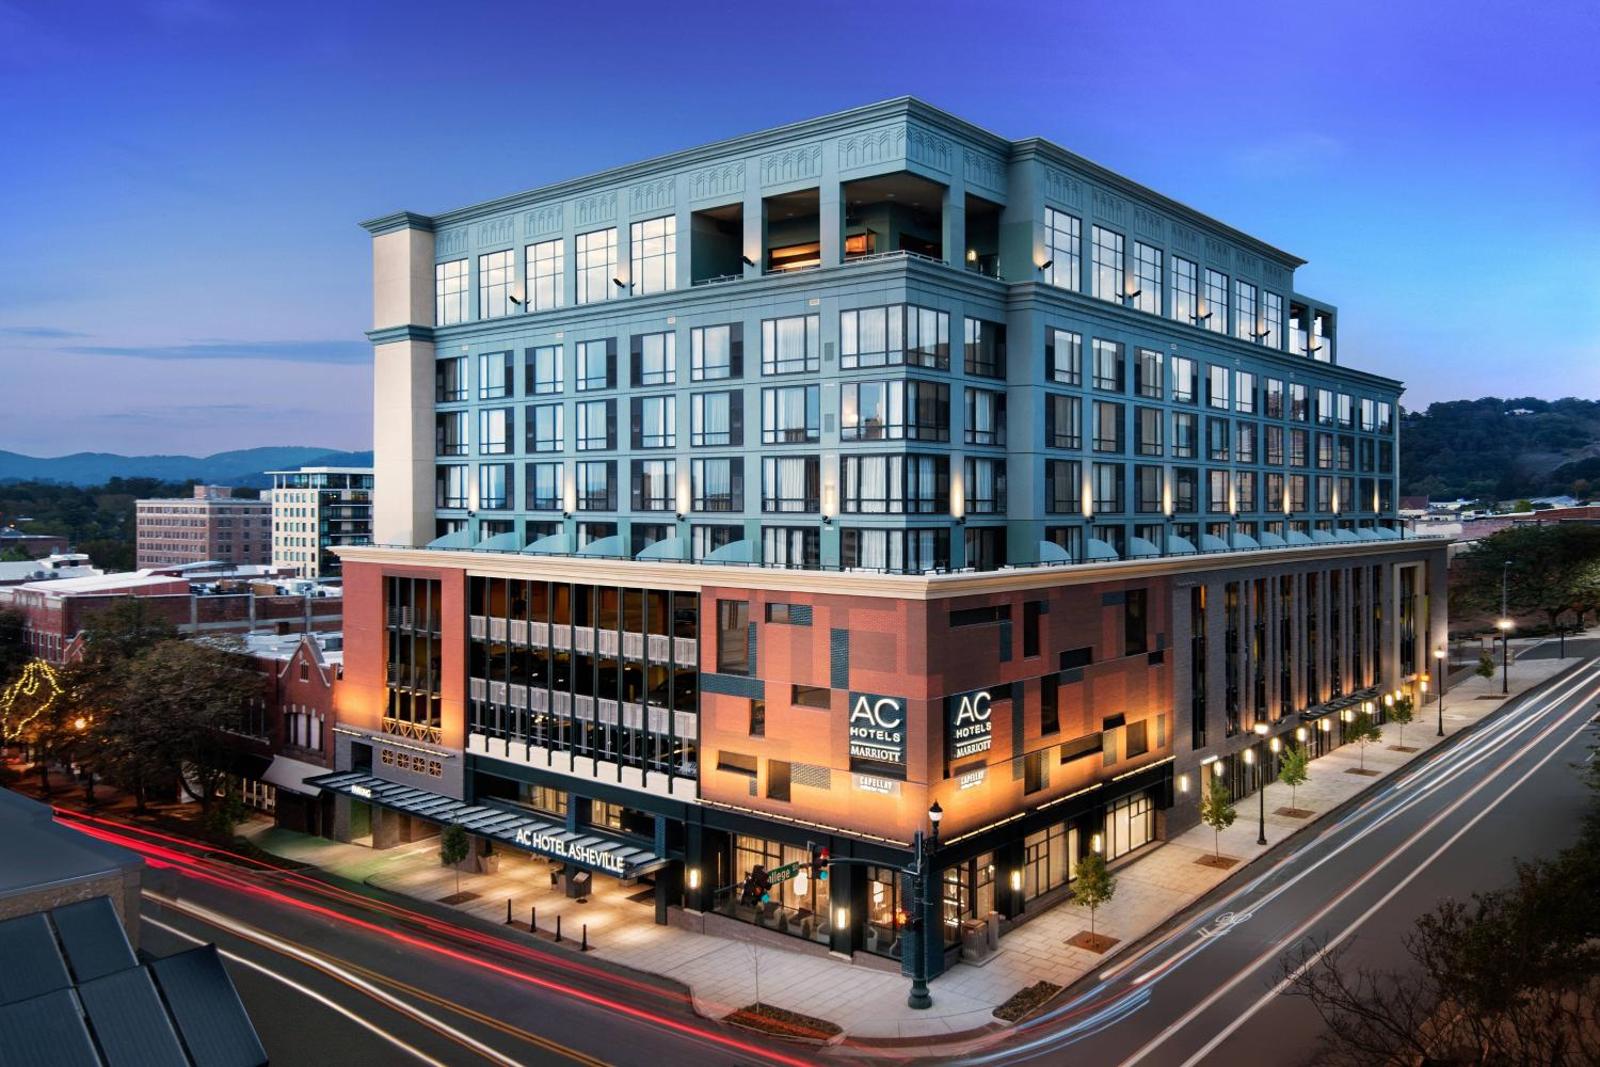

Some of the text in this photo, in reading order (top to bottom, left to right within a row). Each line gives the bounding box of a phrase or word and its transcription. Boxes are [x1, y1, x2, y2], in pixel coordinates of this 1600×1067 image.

[850, 696, 900, 728] AC
[956, 692, 992, 726] AC
[850, 727, 901, 743] HOTELS
[956, 722, 992, 739] HOTELS
[850, 745, 901, 762] MARRIOTT
[956, 740, 992, 758] MARRIOTT
[515, 828, 625, 873] AC HOTEL ASHEVILLE
[767, 868, 790, 884] ollege
